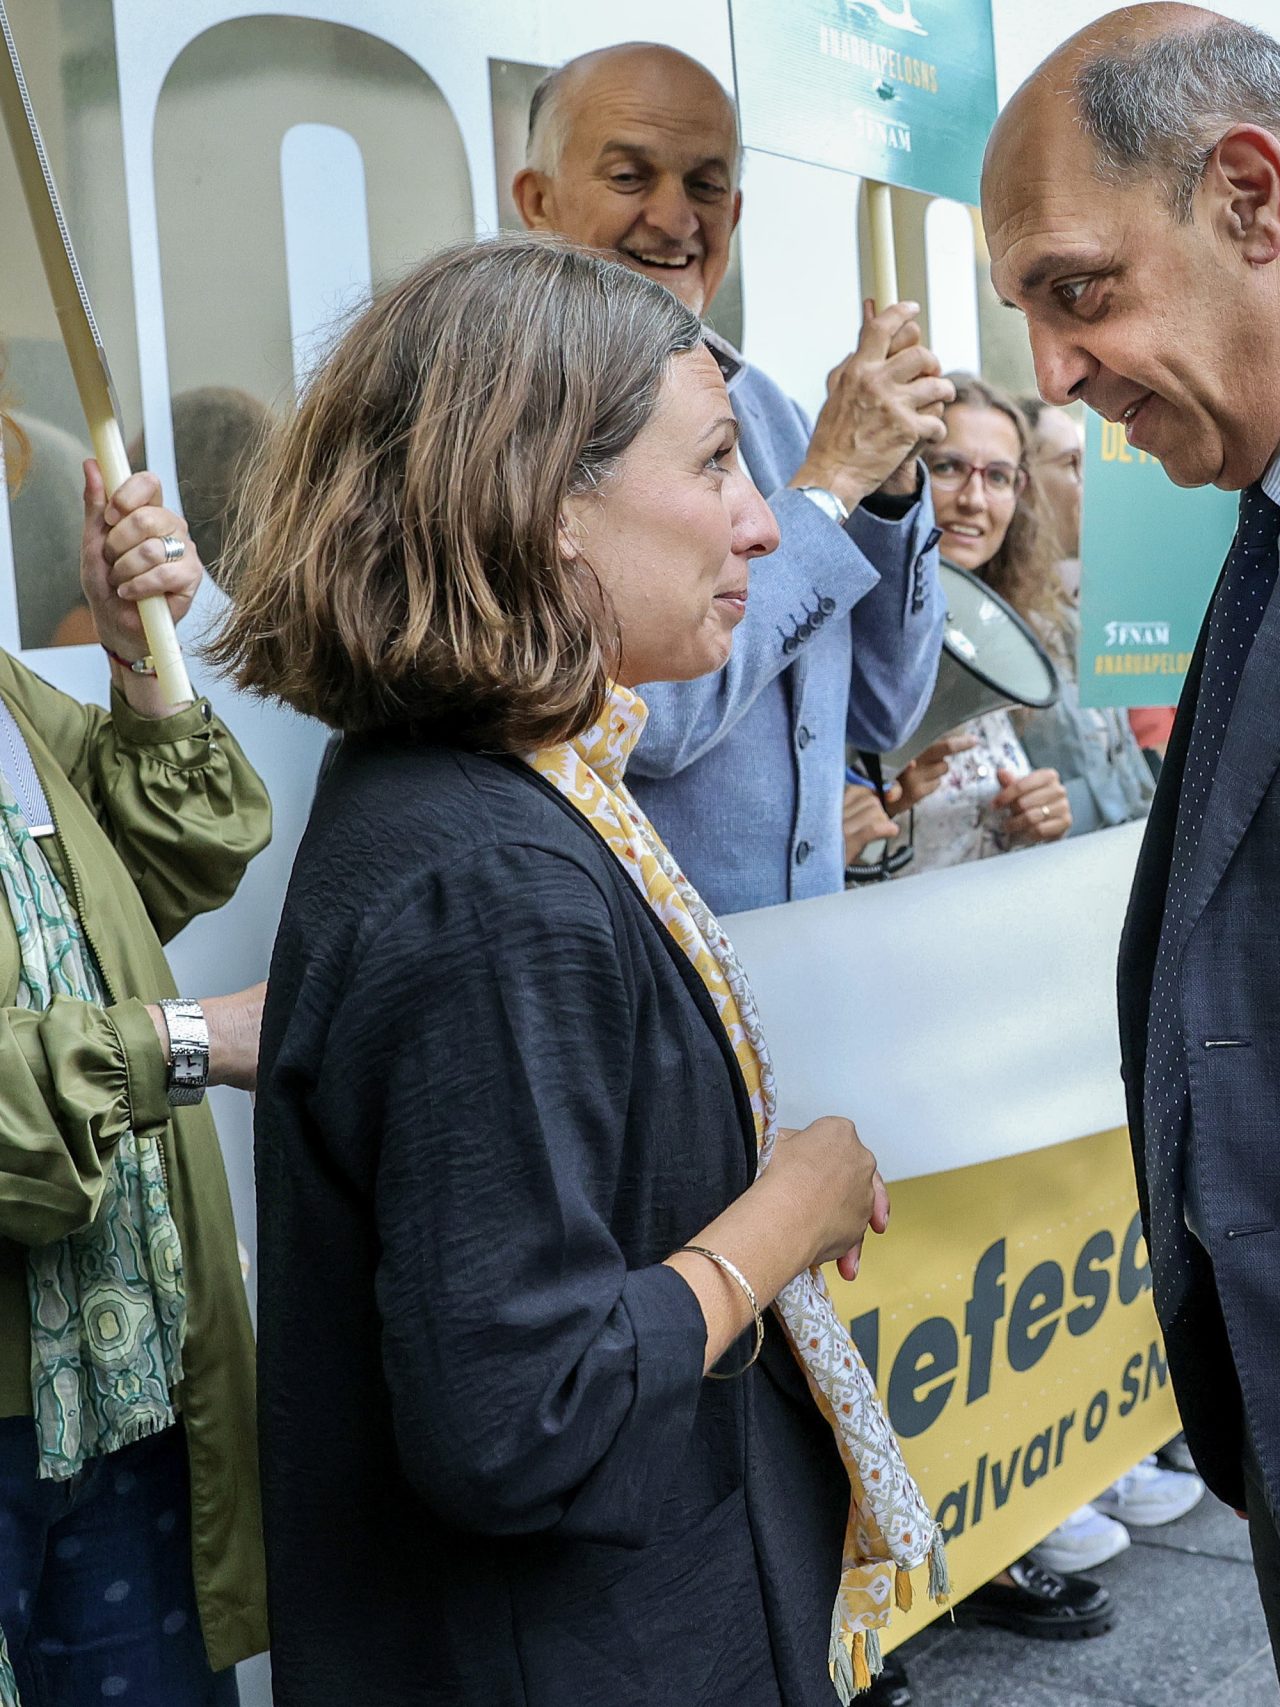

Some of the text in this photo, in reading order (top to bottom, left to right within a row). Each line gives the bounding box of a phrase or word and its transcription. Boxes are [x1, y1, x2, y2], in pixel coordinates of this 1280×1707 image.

[933, 1339, 1169, 1547] alvar o SN
